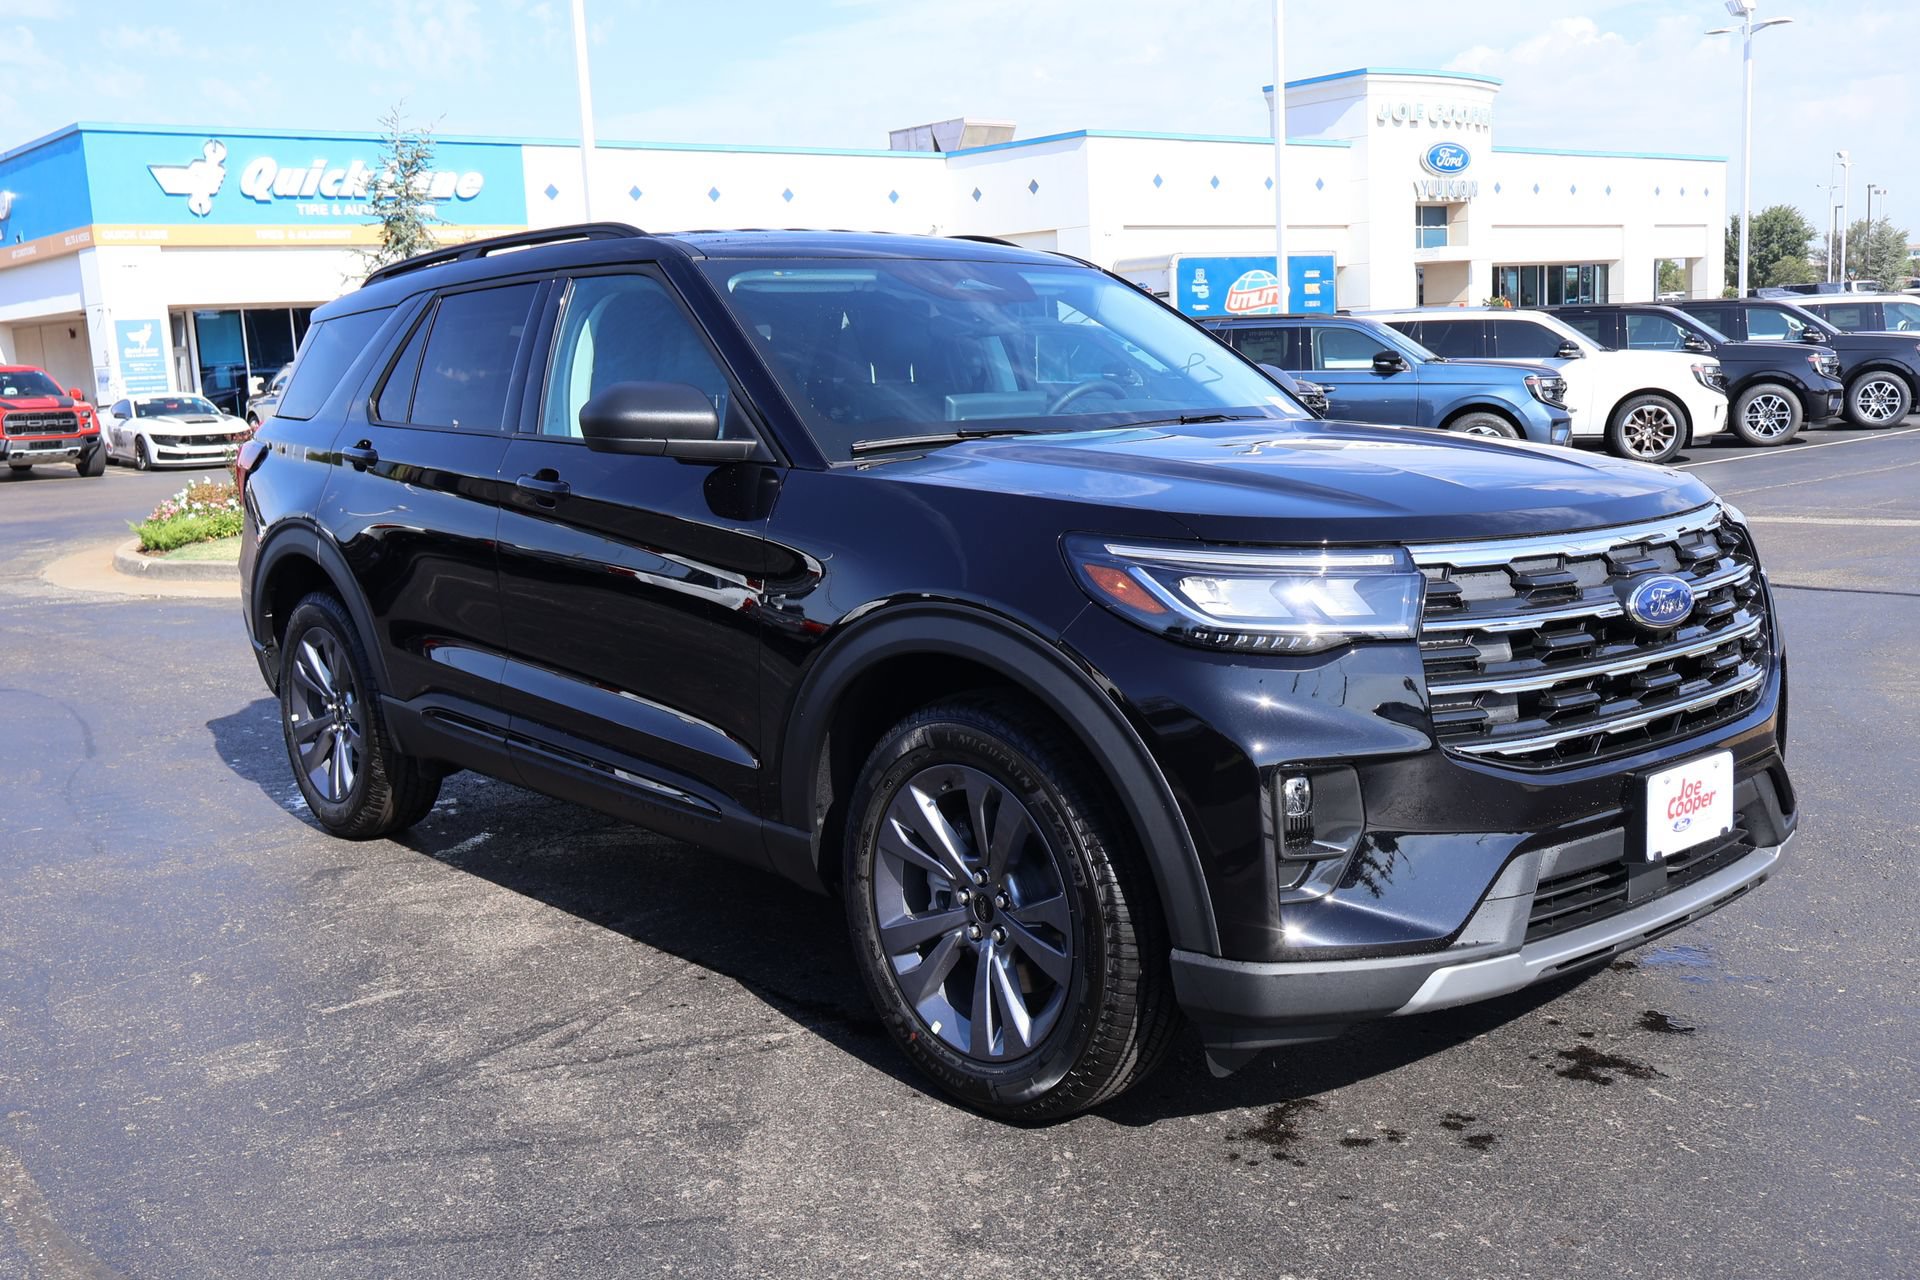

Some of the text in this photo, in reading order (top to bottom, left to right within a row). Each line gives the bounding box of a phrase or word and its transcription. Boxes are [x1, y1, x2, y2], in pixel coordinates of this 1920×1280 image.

[1435, 146, 1464, 168] Ford
[241, 156, 378, 204] Quick
[1418, 180, 1478, 199] YUKON
[296, 204, 329, 216] TIRE
[332, 204, 342, 216] &
[1228, 288, 1279, 311] UTILIT
[4, 418, 75, 428] FORD
[1650, 586, 1685, 617] Ford
[1677, 777, 1702, 802] Joe
[1667, 790, 1717, 820] Cooper
